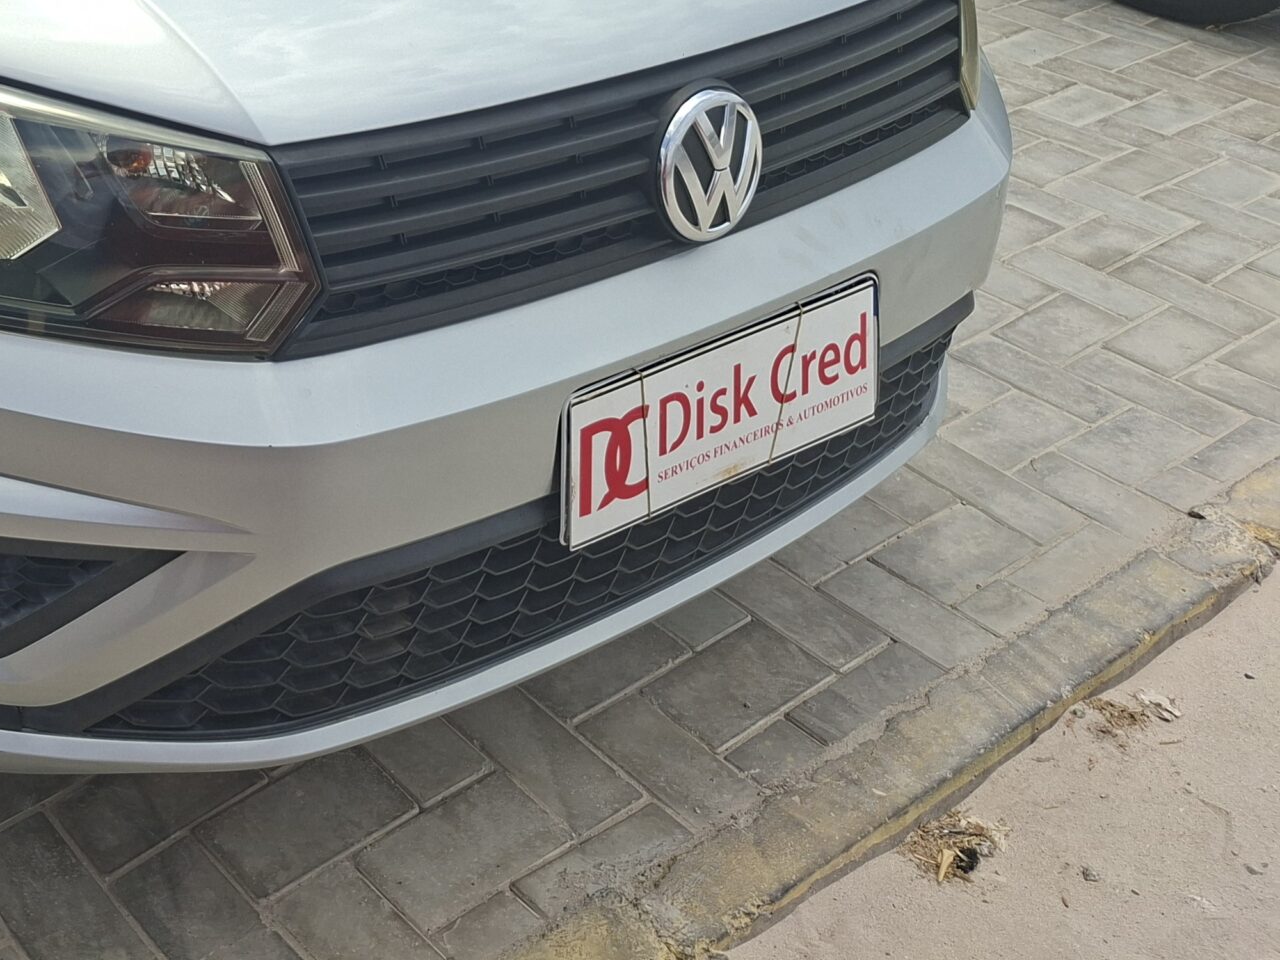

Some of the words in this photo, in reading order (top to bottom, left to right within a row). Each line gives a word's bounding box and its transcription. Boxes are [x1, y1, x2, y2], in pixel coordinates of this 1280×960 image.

[657, 452, 711, 484] SERVIÇOS
[713, 419, 785, 459] FINANCEIROS
[796, 382, 869, 424] AUTOMOTIVOS
[658, 363, 758, 457] Disk
[770, 312, 868, 405] Cred
